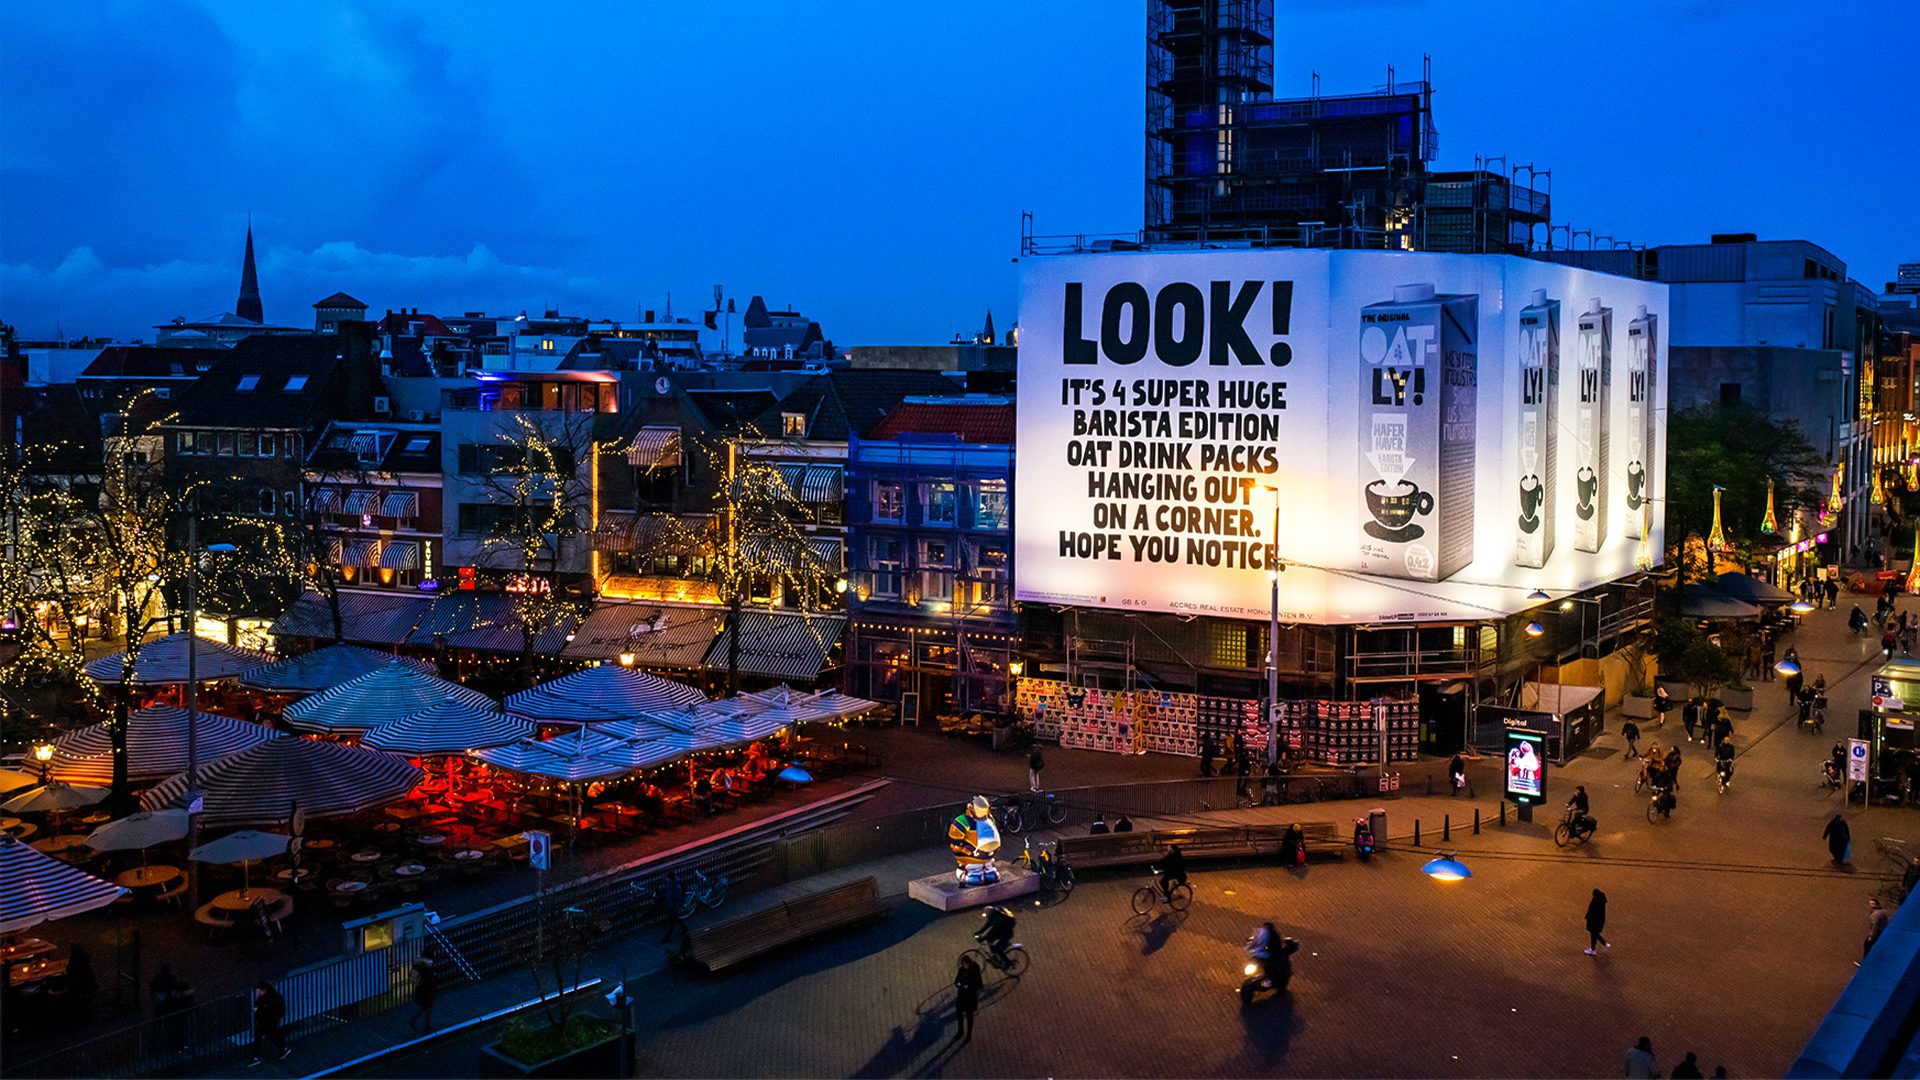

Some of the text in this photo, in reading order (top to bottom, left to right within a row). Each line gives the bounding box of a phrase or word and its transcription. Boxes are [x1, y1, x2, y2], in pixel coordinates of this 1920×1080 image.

[1064, 281, 1293, 367] LOOK!
[1112, 379, 1126, 406] 4
[1133, 379, 1210, 408] SUPER
[1218, 380, 1287, 410] HUGE
[1372, 367, 1426, 406] LY!
[1523, 367, 1543, 405] LY!
[1580, 369, 1598, 403] LY!
[1630, 371, 1645, 402] LY!
[1073, 409, 1280, 442] BARISTA EDITION
[1373, 423, 1404, 437] HAFER
[1067, 440, 1279, 475] OAT DRINK PACKS
[1375, 437, 1404, 451] HAVER
[1088, 471, 1256, 505] HANGING OUT
[1093, 502, 1261, 538] ON A CORNER.
[1059, 531, 1122, 561] HOPE
[1129, 536, 1179, 564] YOU
[1169, 601, 1198, 610] ACCRES
[1200, 603, 1218, 612] REAL
[1220, 605, 1245, 614] ESTATE
[1503, 717, 1527, 727] Digital
